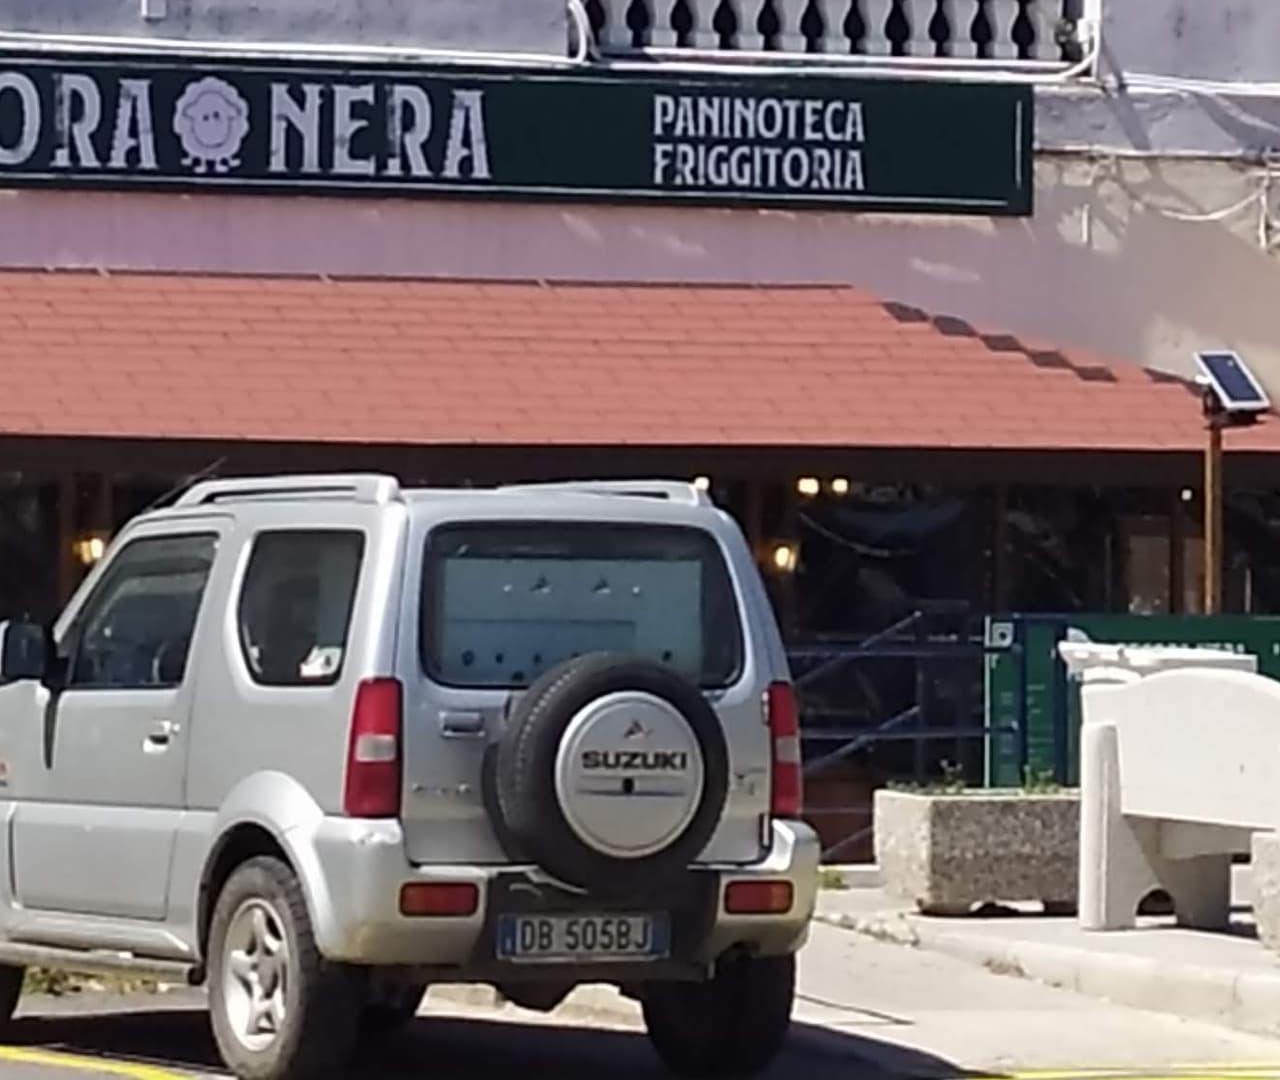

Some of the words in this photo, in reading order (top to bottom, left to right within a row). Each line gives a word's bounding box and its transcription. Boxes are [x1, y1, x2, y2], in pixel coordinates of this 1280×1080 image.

[266, 81, 493, 180] NERA
[653, 94, 865, 142] PANINOTECA
[652, 143, 865, 191] FRIGGITORIA
[581, 750, 688, 770] SUZUKI
[521, 919, 553, 951] DB
[565, 918, 649, 951] 505BJ
